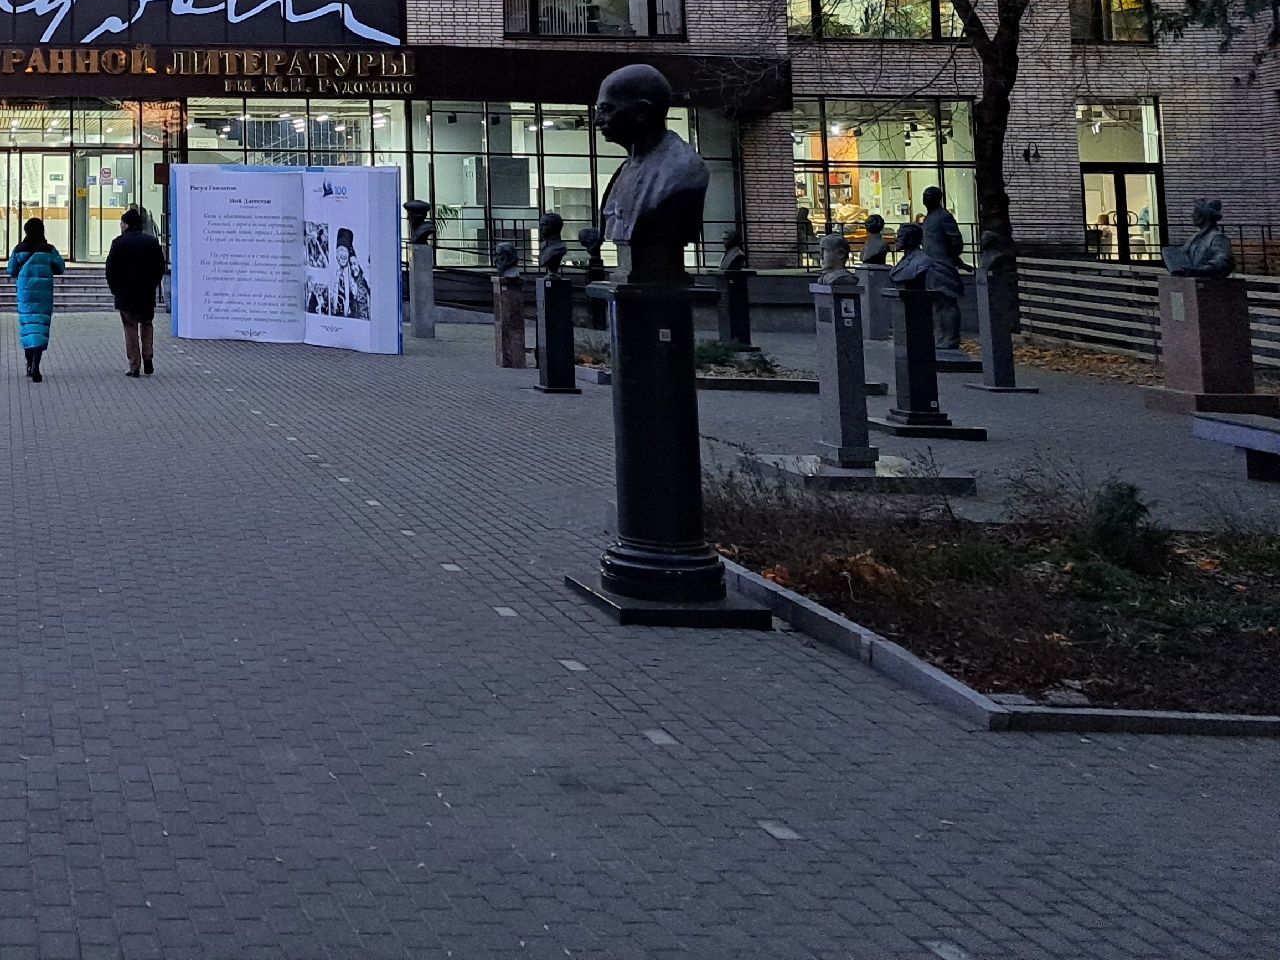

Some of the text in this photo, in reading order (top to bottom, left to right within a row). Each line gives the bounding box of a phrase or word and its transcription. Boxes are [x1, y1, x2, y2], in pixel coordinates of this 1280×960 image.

[166, 49, 416, 77] ЛИТЕРАТУРЫ
[190, 184, 207, 192] Расул
[334, 186, 347, 195] 100
